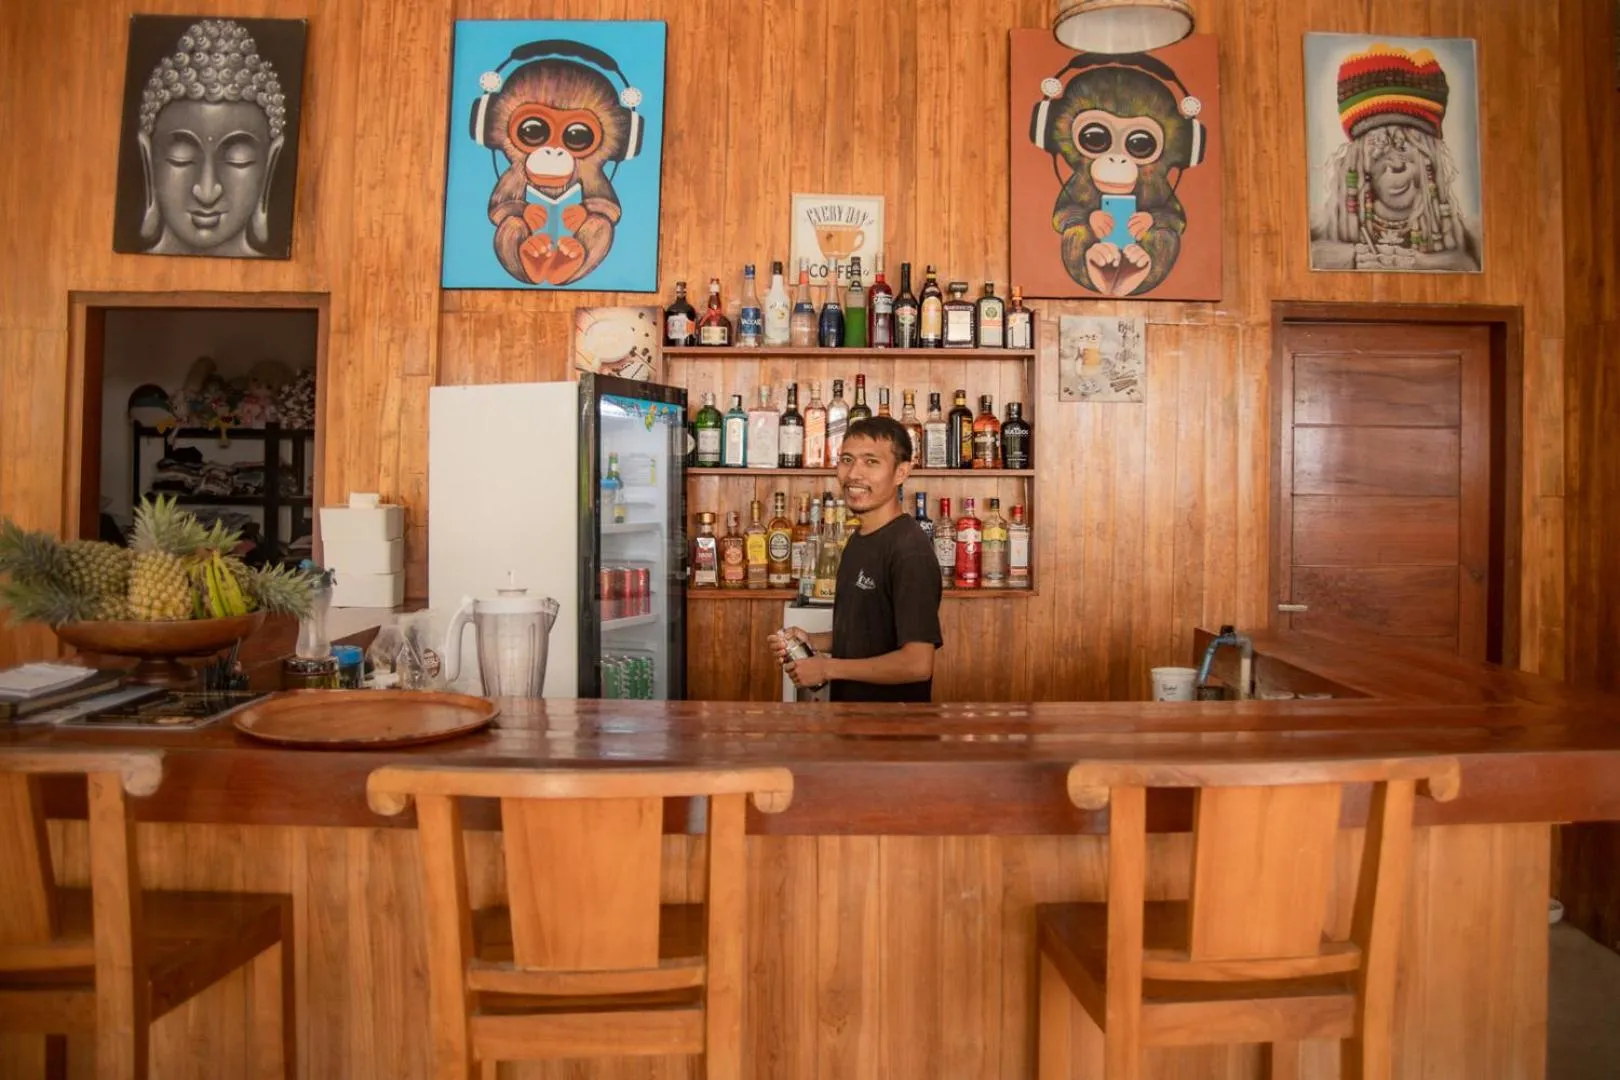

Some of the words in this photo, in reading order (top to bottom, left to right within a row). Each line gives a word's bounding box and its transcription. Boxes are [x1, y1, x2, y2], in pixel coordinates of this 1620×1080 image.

[805, 204, 844, 226] EVERY
[846, 206, 869, 225] DAY
[809, 263, 861, 280] COFE
